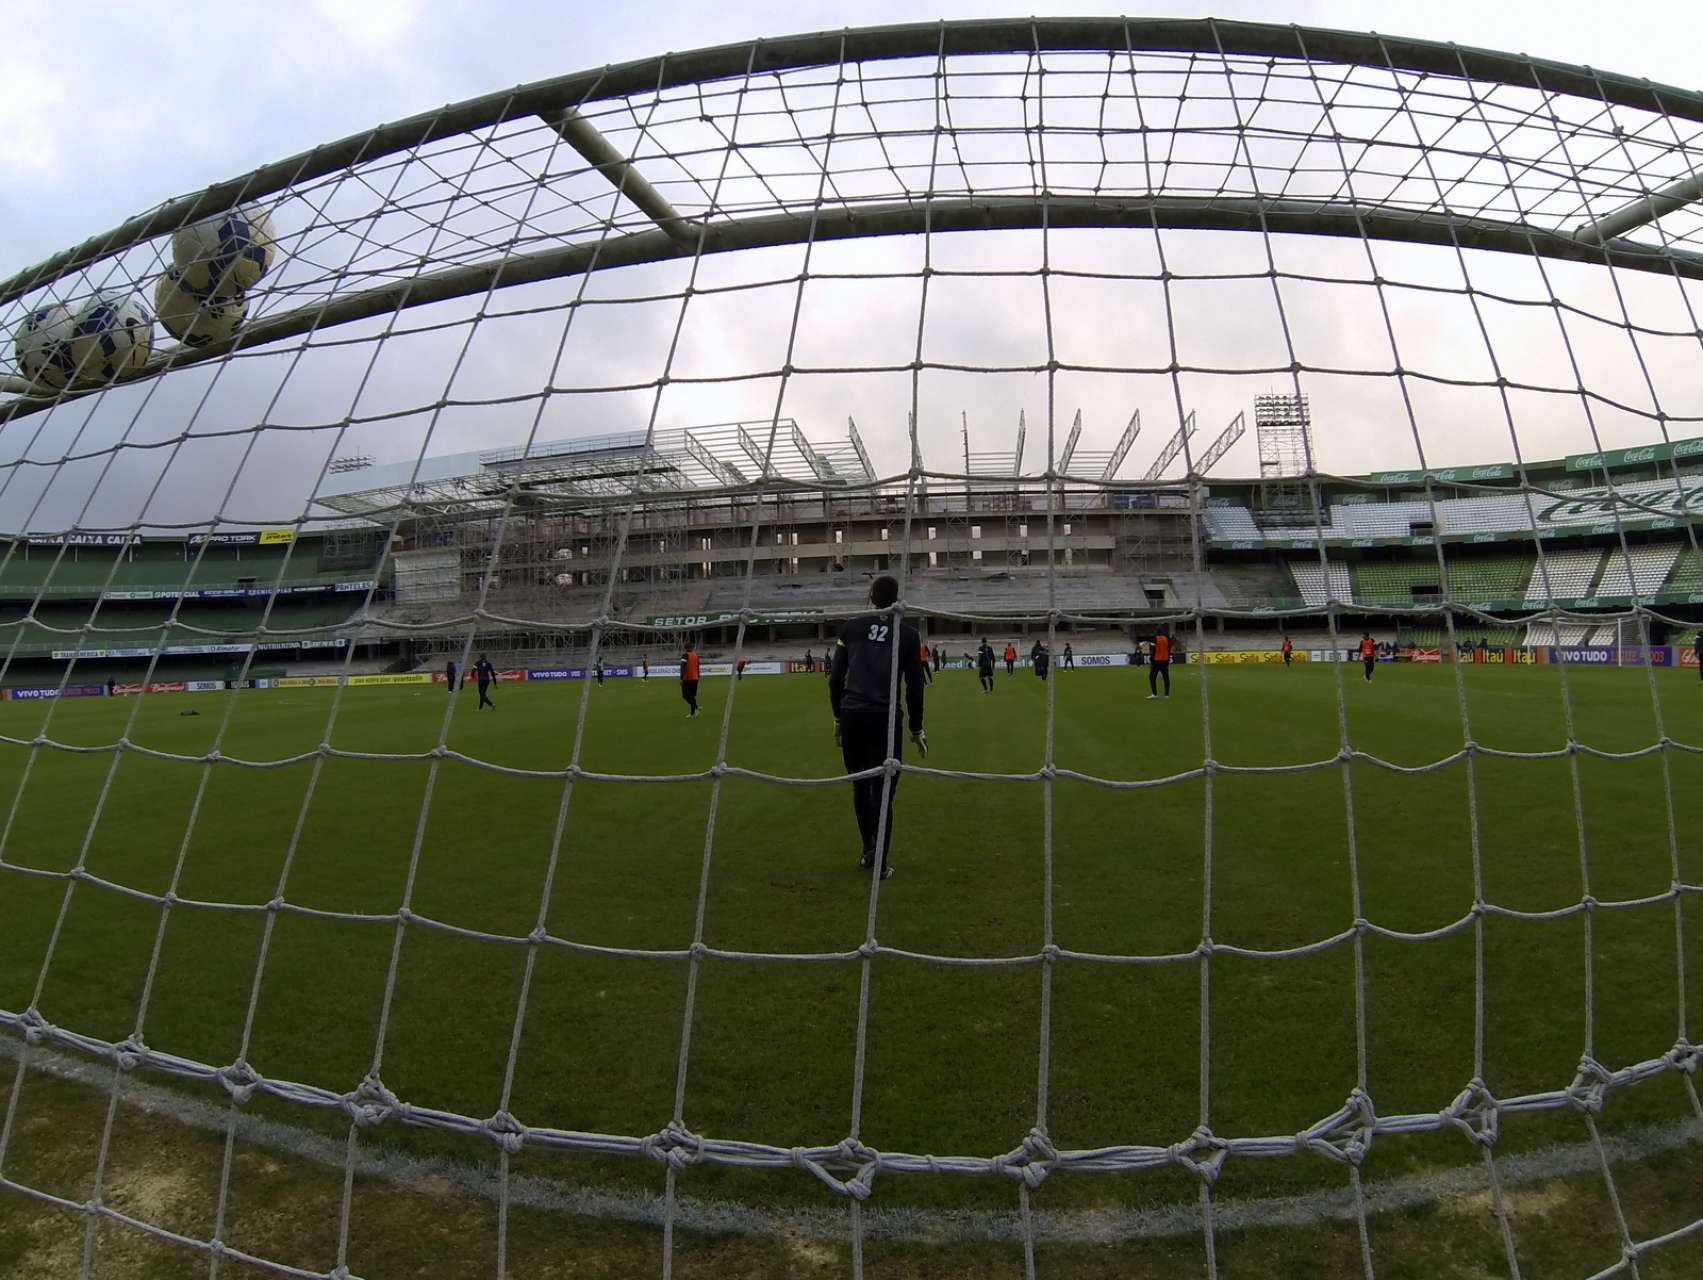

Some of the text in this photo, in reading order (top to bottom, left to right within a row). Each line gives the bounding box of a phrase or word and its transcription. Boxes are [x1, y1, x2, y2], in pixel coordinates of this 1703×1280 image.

[69, 535, 102, 544] CAIXA
[654, 616, 707, 626] SETOR
[868, 624, 888, 641] 32
[1081, 656, 1110, 665] SOMOS
[1483, 649, 1504, 662] Itaú
[1581, 651, 1607, 662] TUDO
[1610, 651, 1637, 664] LGUE
[17, 689, 39, 698] VIVO
